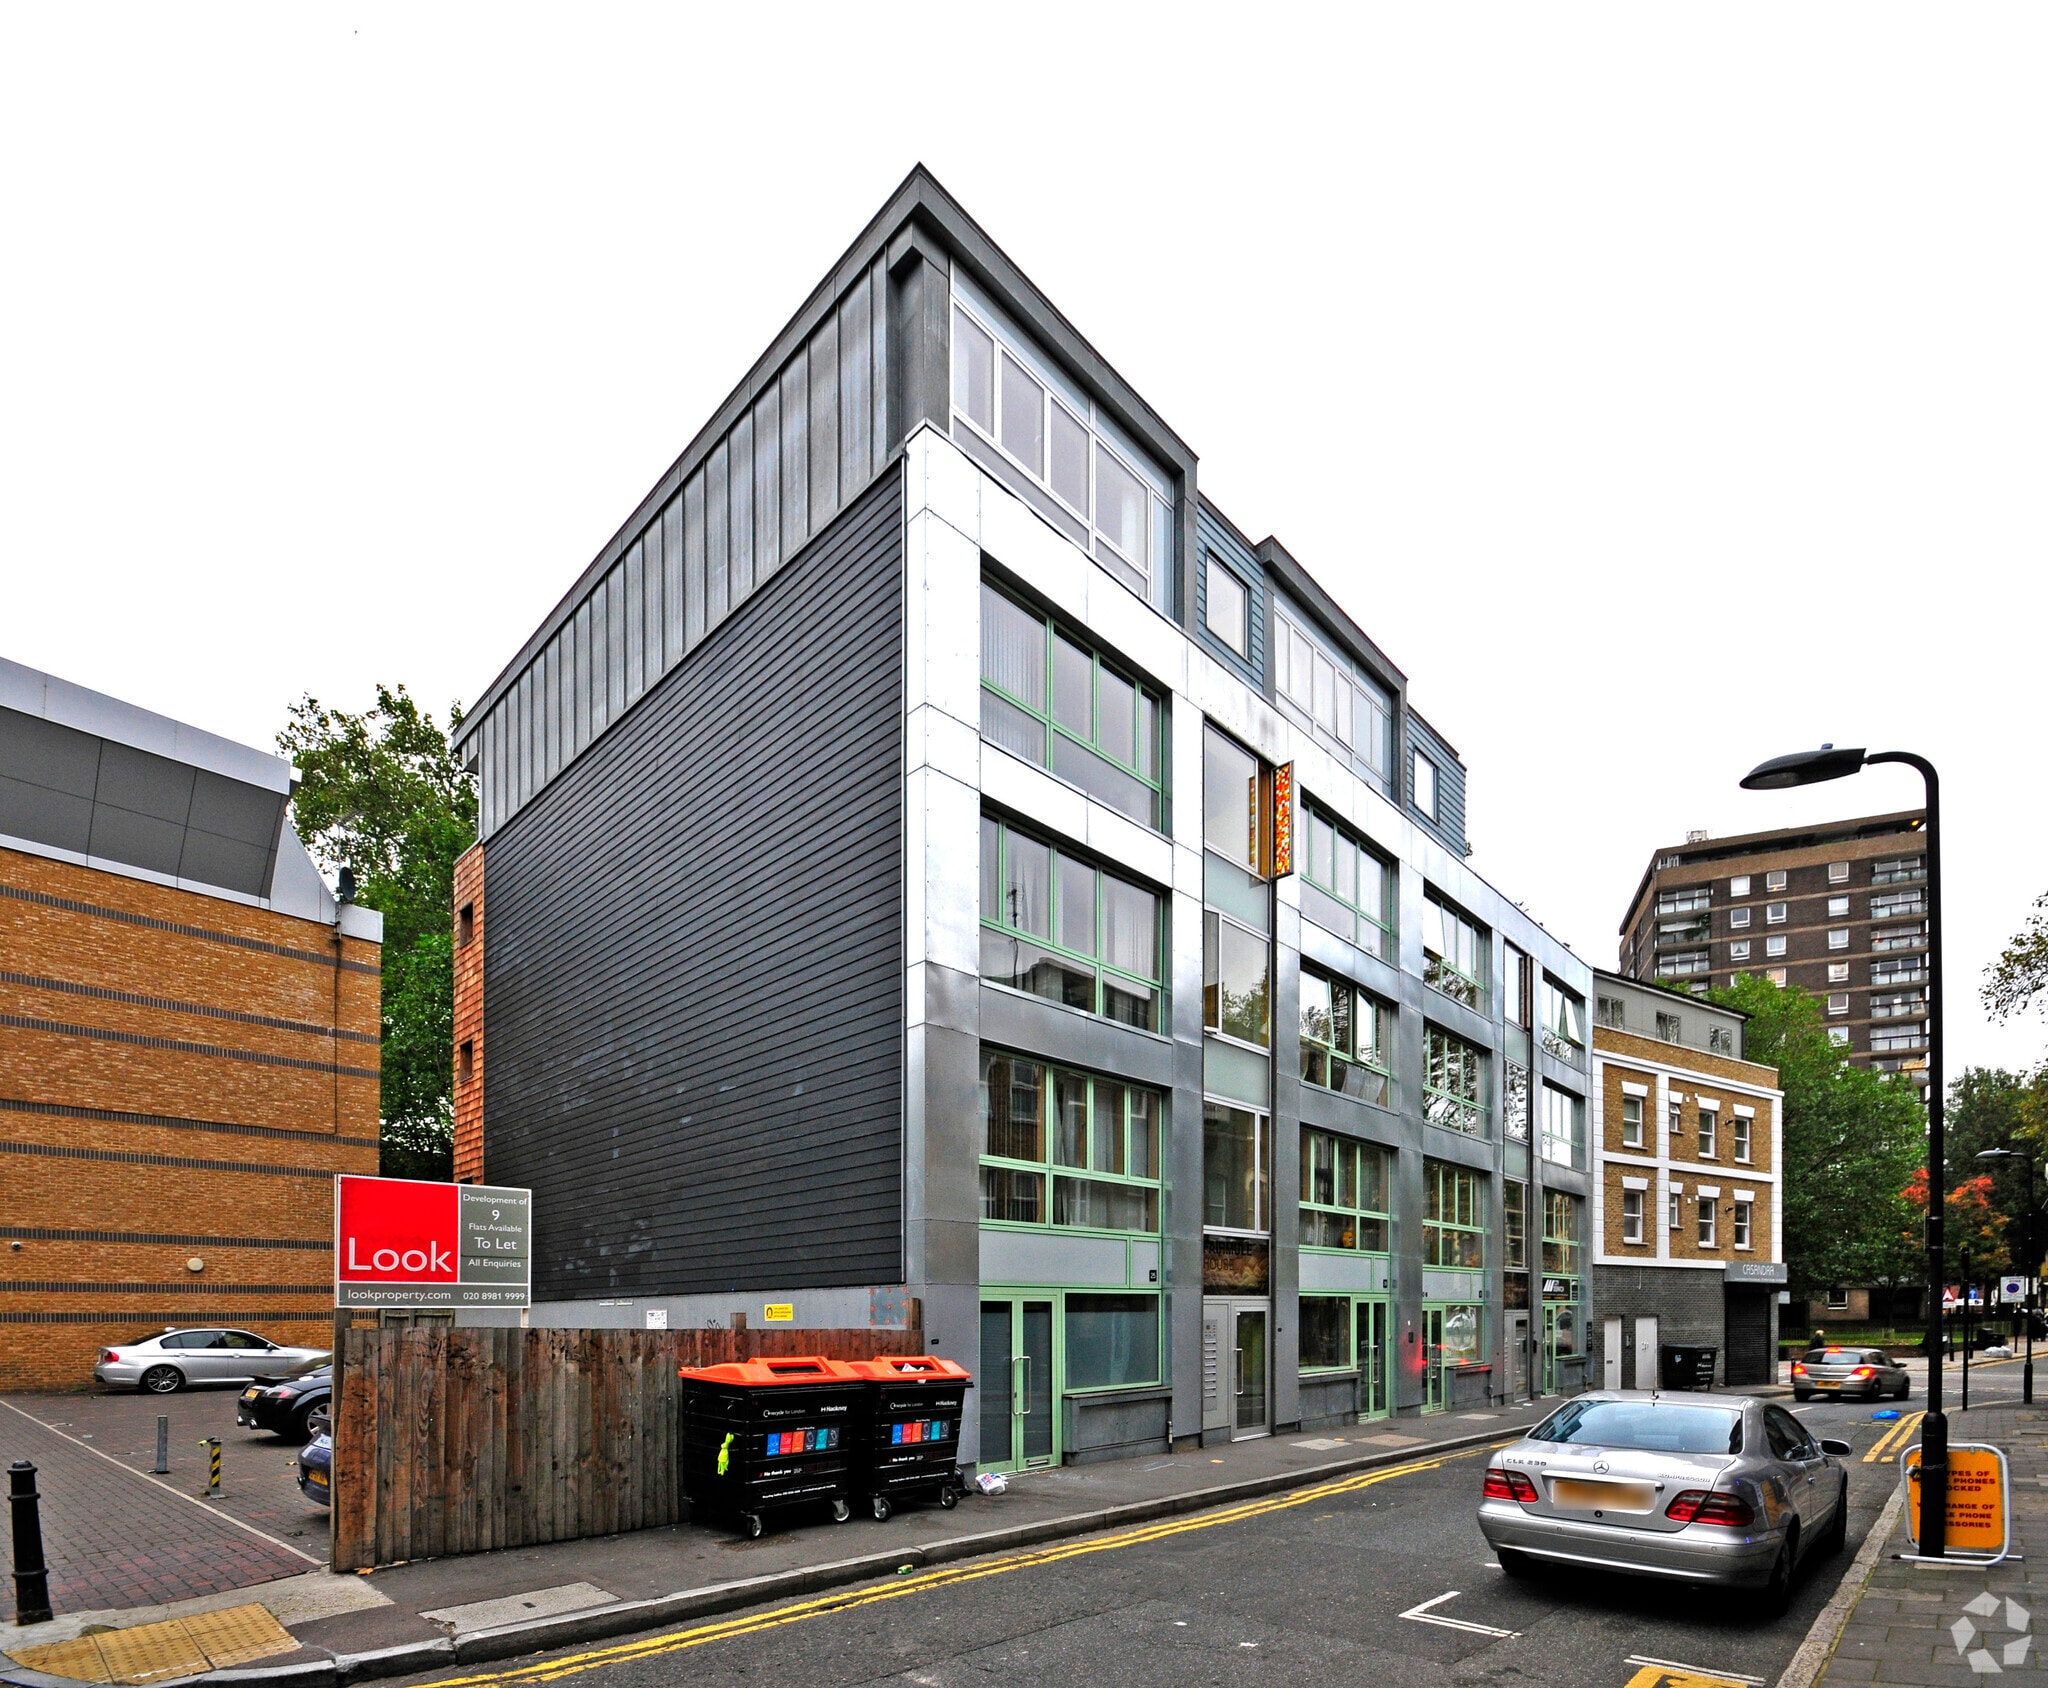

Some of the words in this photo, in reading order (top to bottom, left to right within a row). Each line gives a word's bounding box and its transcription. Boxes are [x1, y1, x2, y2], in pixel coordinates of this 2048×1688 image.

[463, 1193, 517, 1205] Development
[491, 1209, 500, 1221] 9
[468, 1222, 487, 1231] Flats
[488, 1223, 522, 1233] Available
[474, 1236, 491, 1249] To
[495, 1237, 517, 1250] Let
[348, 1237, 453, 1273] Look
[468, 1258, 480, 1267] All
[483, 1258, 522, 1270] Enquiries
[347, 1289, 451, 1305] lookproperty.com
[463, 1292, 480, 1301] 020
[481, 1292, 501, 1301] 8981
[504, 1292, 526, 1301] 9999
